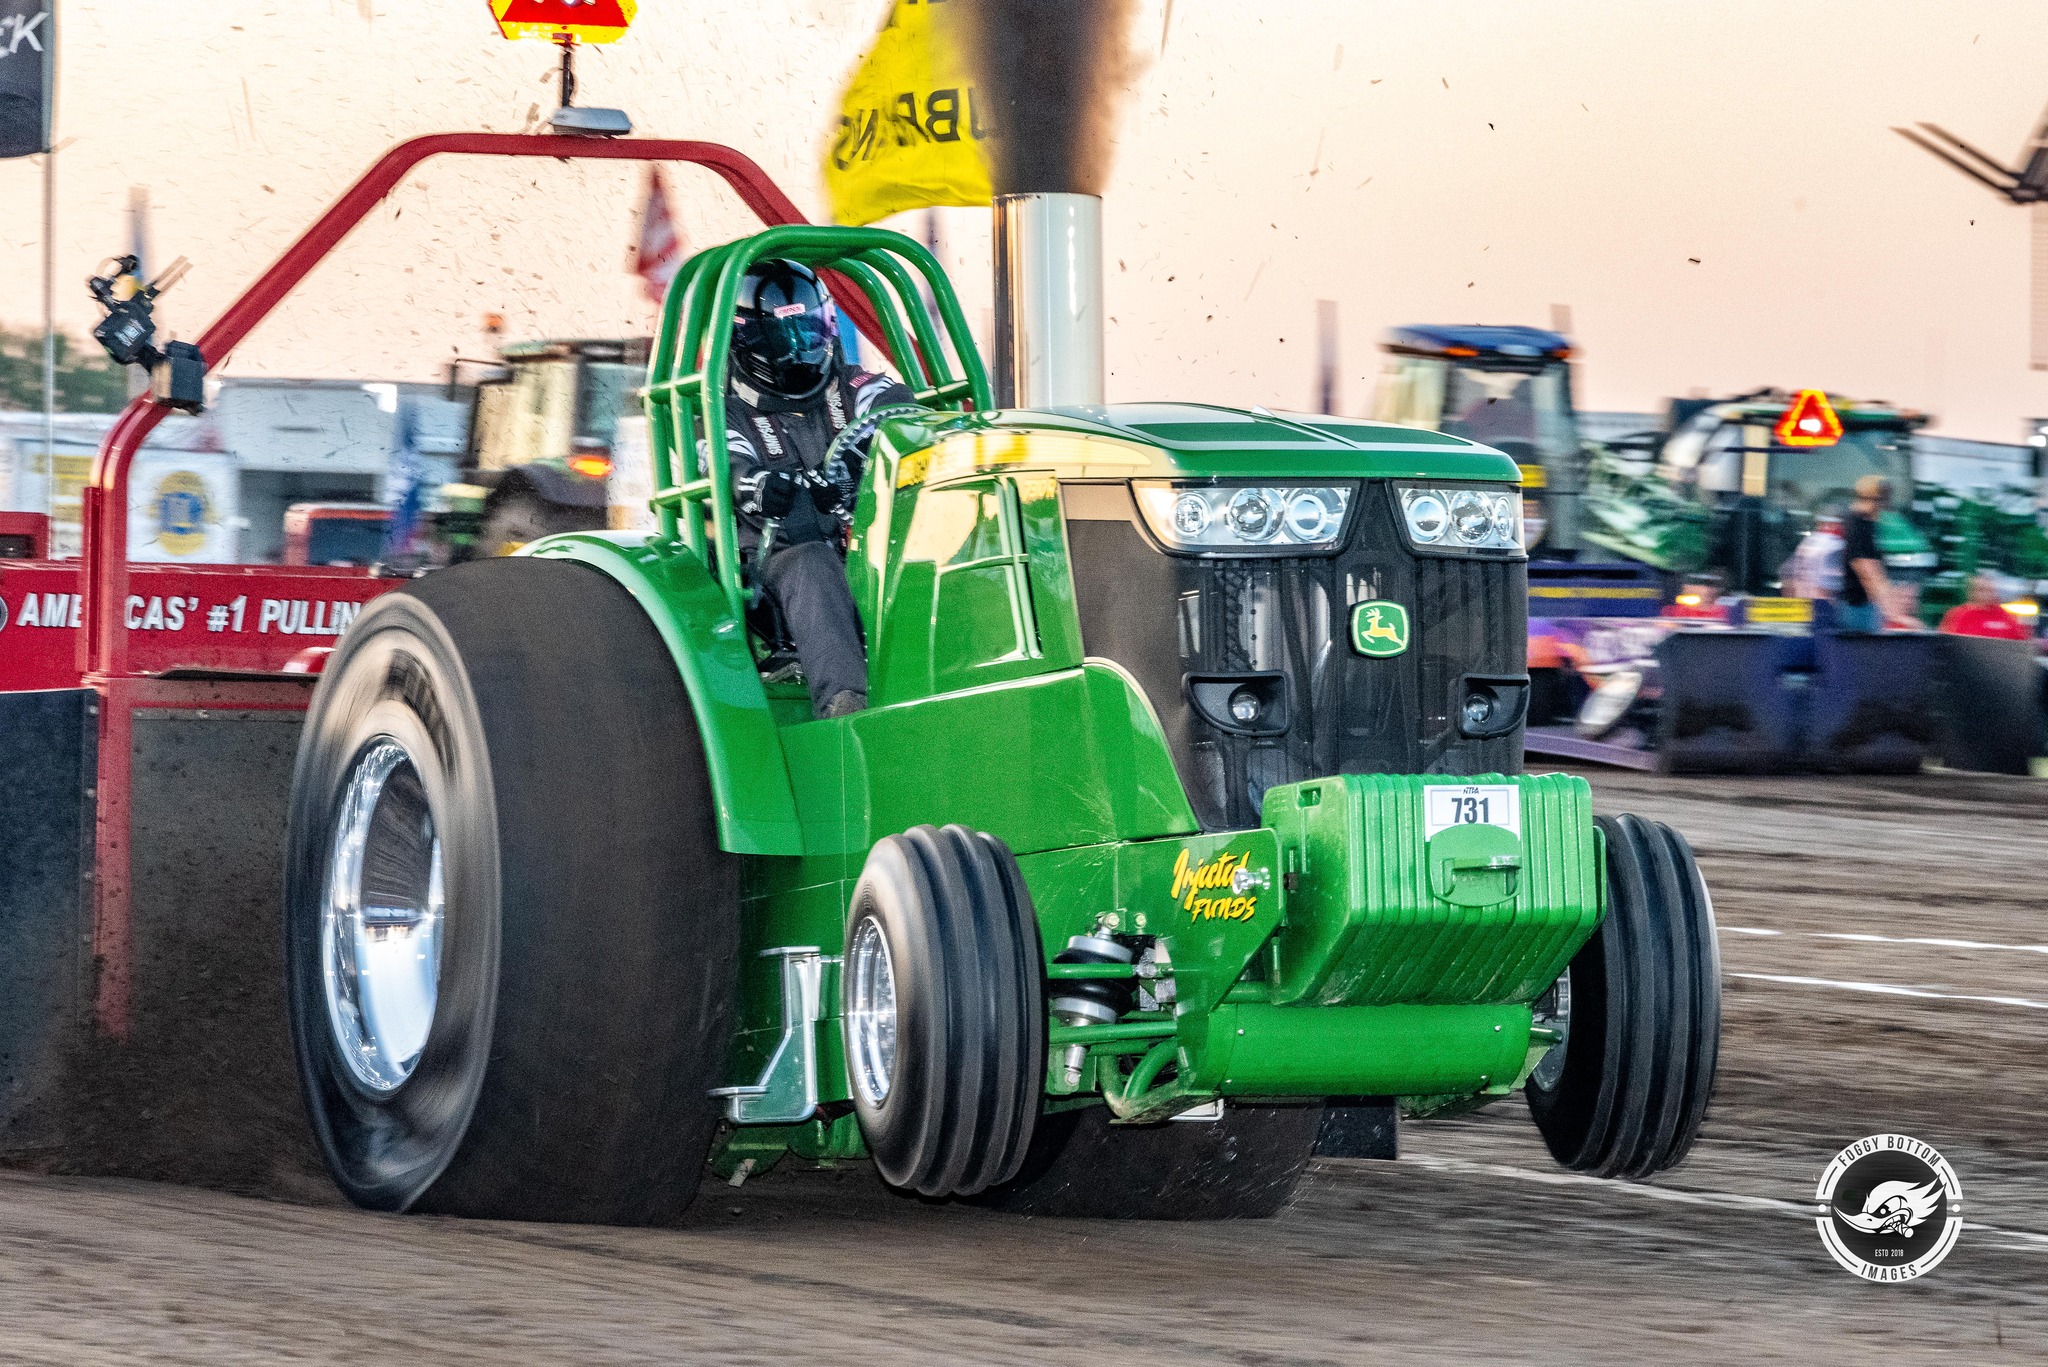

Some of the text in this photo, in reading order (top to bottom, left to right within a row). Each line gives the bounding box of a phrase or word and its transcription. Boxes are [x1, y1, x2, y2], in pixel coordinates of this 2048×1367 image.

[752, 416, 783, 455] SIMPSON
[16, 592, 198, 630] AMECAS'
[206, 594, 247, 632] #1
[1462, 786, 1480, 795] NTPA
[1451, 797, 1489, 824] 731
[1191, 896, 1257, 922] FUNDS
